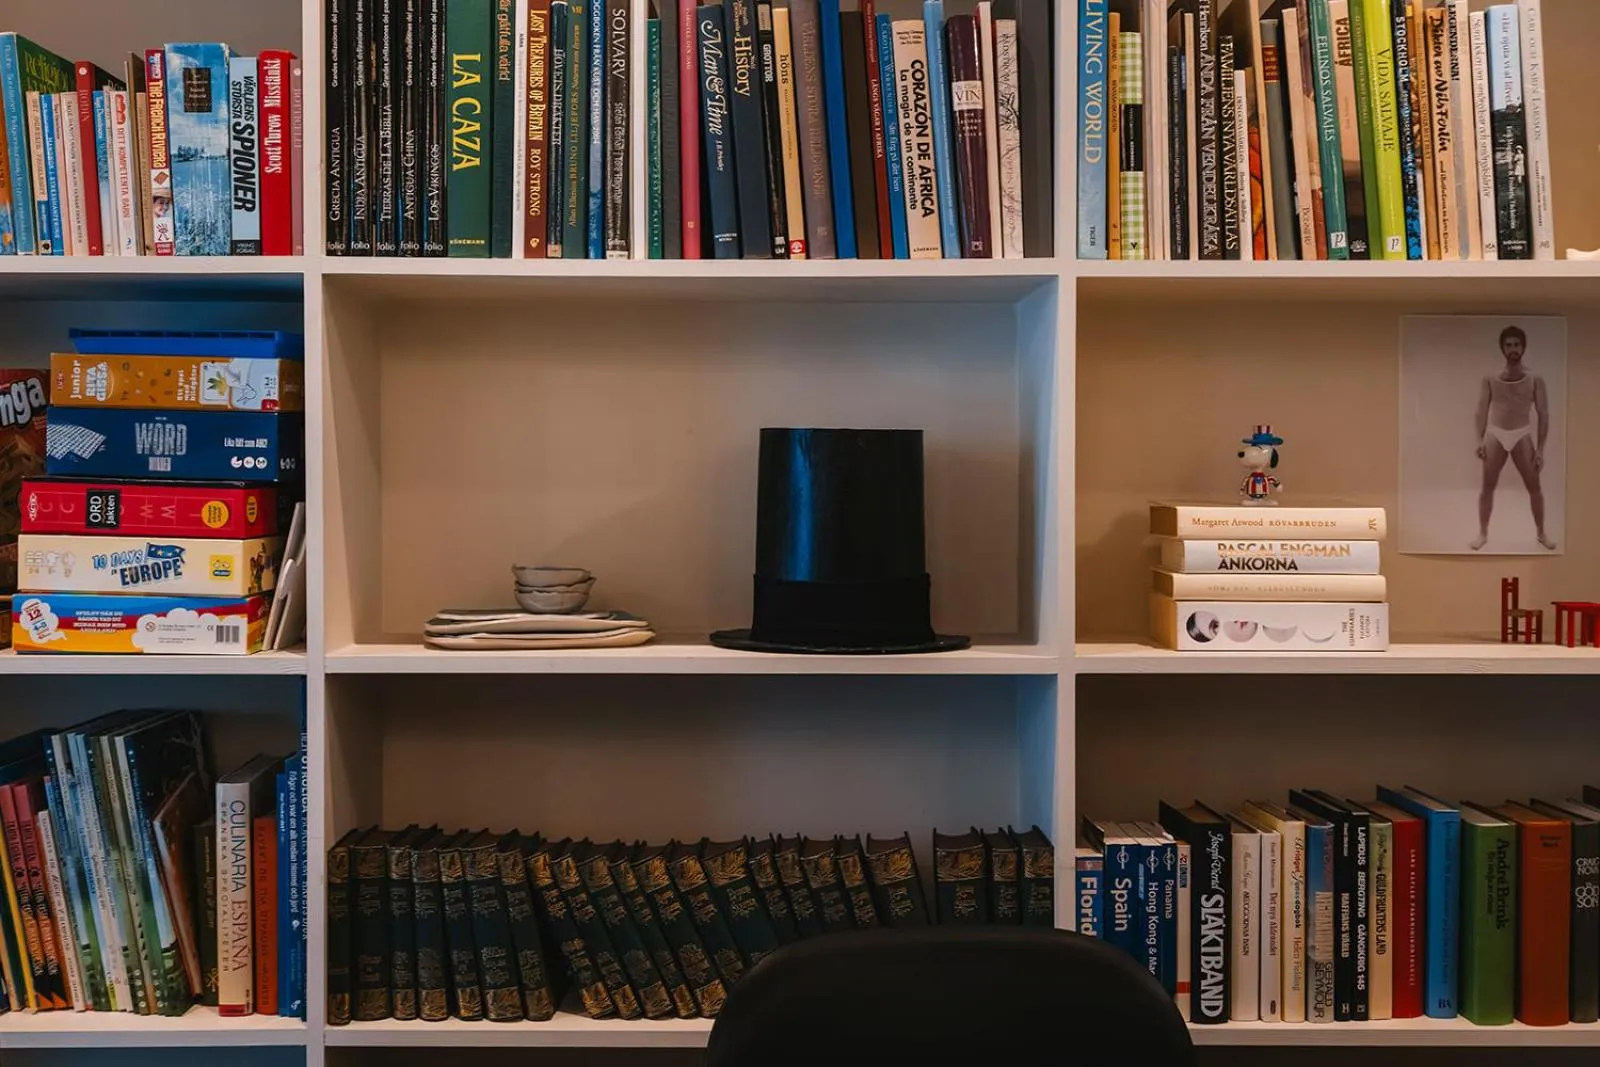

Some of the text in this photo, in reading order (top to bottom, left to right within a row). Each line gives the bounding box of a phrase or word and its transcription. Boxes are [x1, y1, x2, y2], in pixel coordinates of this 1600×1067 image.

[592, 44, 602, 65] FRÅN
[612, 8, 626, 79] SOLVARV
[762, 44, 773, 83] GROTTOR
[1334, 17, 1351, 67] ÁFRICA
[1395, 16, 1409, 82] STOCKHOLM
[499, 54, 512, 80] värld
[701, 20, 728, 136] Man & Time
[734, 36, 752, 96] History
[780, 54, 791, 84] höns
[1084, 0, 1103, 164] LIVING WORLD
[1200, 52, 1217, 95] ÄNDA
[232, 80, 243, 119] STÖRSTA
[244, 76, 254, 121] VÄRLDENS
[592, 88, 600, 106] OCH
[911, 59, 932, 138] CORAZÓN
[955, 91, 981, 101] VIN
[1317, 35, 1334, 142] FELINOS SALVAJES
[1377, 48, 1395, 152] VIDA SALVAJE
[1434, 78, 1448, 109] Nils
[264, 59, 281, 173] Scott Turow Misstänkt
[380, 104, 392, 138] BIBLIA
[452, 53, 480, 171] LA CAZA
[529, 10, 547, 217] LOST TREASURES OF BRITAIN ROY STRONG
[614, 102, 623, 124] Stefan
[1200, 98, 1217, 141] FRÅN
[1436, 110, 1450, 153] Ferlin
[570, 92, 579, 178] BRUNO LILJEFORS
[592, 127, 601, 144] 2004
[875, 132, 883, 159] AFRIKA
[900, 69, 918, 211] La magia de un continente
[916, 142, 931, 161] DE
[1220, 42, 1238, 250] FAMILJENS NYA VÄRLDSATLAS
[233, 122, 256, 212] SPIONER
[330, 127, 340, 221] GRECIA ANTIGUA
[354, 136, 365, 220] INDIA ANTIGUA
[382, 161, 392, 175] DE
[404, 130, 414, 220] ANTIGUA CHINA
[428, 144, 440, 220] LOS VIKINGOS
[381, 178, 392, 221] TIERRAS
[921, 166, 937, 218] ÁFRICA
[1200, 143, 1218, 253] VENDELKRÅKA
[326, 241, 345, 250] folio
[350, 241, 370, 249] folio
[377, 242, 396, 251] folio
[400, 241, 420, 249] folio
[424, 242, 443, 251] folio
[1089, 226, 1097, 247] TIGER
[135, 422, 188, 456] WORD
[89, 495, 101, 523] ORD
[1192, 518, 1337, 527] Margaret Atwood RÖVARBRUDEN
[92, 549, 144, 569] 10 DAYS
[1218, 543, 1351, 557] PASCAL ENGMAN
[1218, 557, 1298, 571] ÄNKORNA
[119, 559, 184, 586] EUROPE
[230, 800, 251, 972] CULINARIA ESPAÑA
[1110, 878, 1132, 931] Spain
[1146, 882, 1158, 913] Hong
[1165, 879, 1174, 919] Panama
[1496, 838, 1510, 929] André Brink
[1341, 893, 1349, 932] MAFFIANS
[1357, 826, 1365, 990] LAPIDUS BERGTING 145
[1146, 916, 1158, 945] Kong
[1376, 935, 1387, 955] LAND
[1201, 894, 1225, 1018] SLÄKTBAND
[1315, 961, 1324, 1018] SEYMOUR
